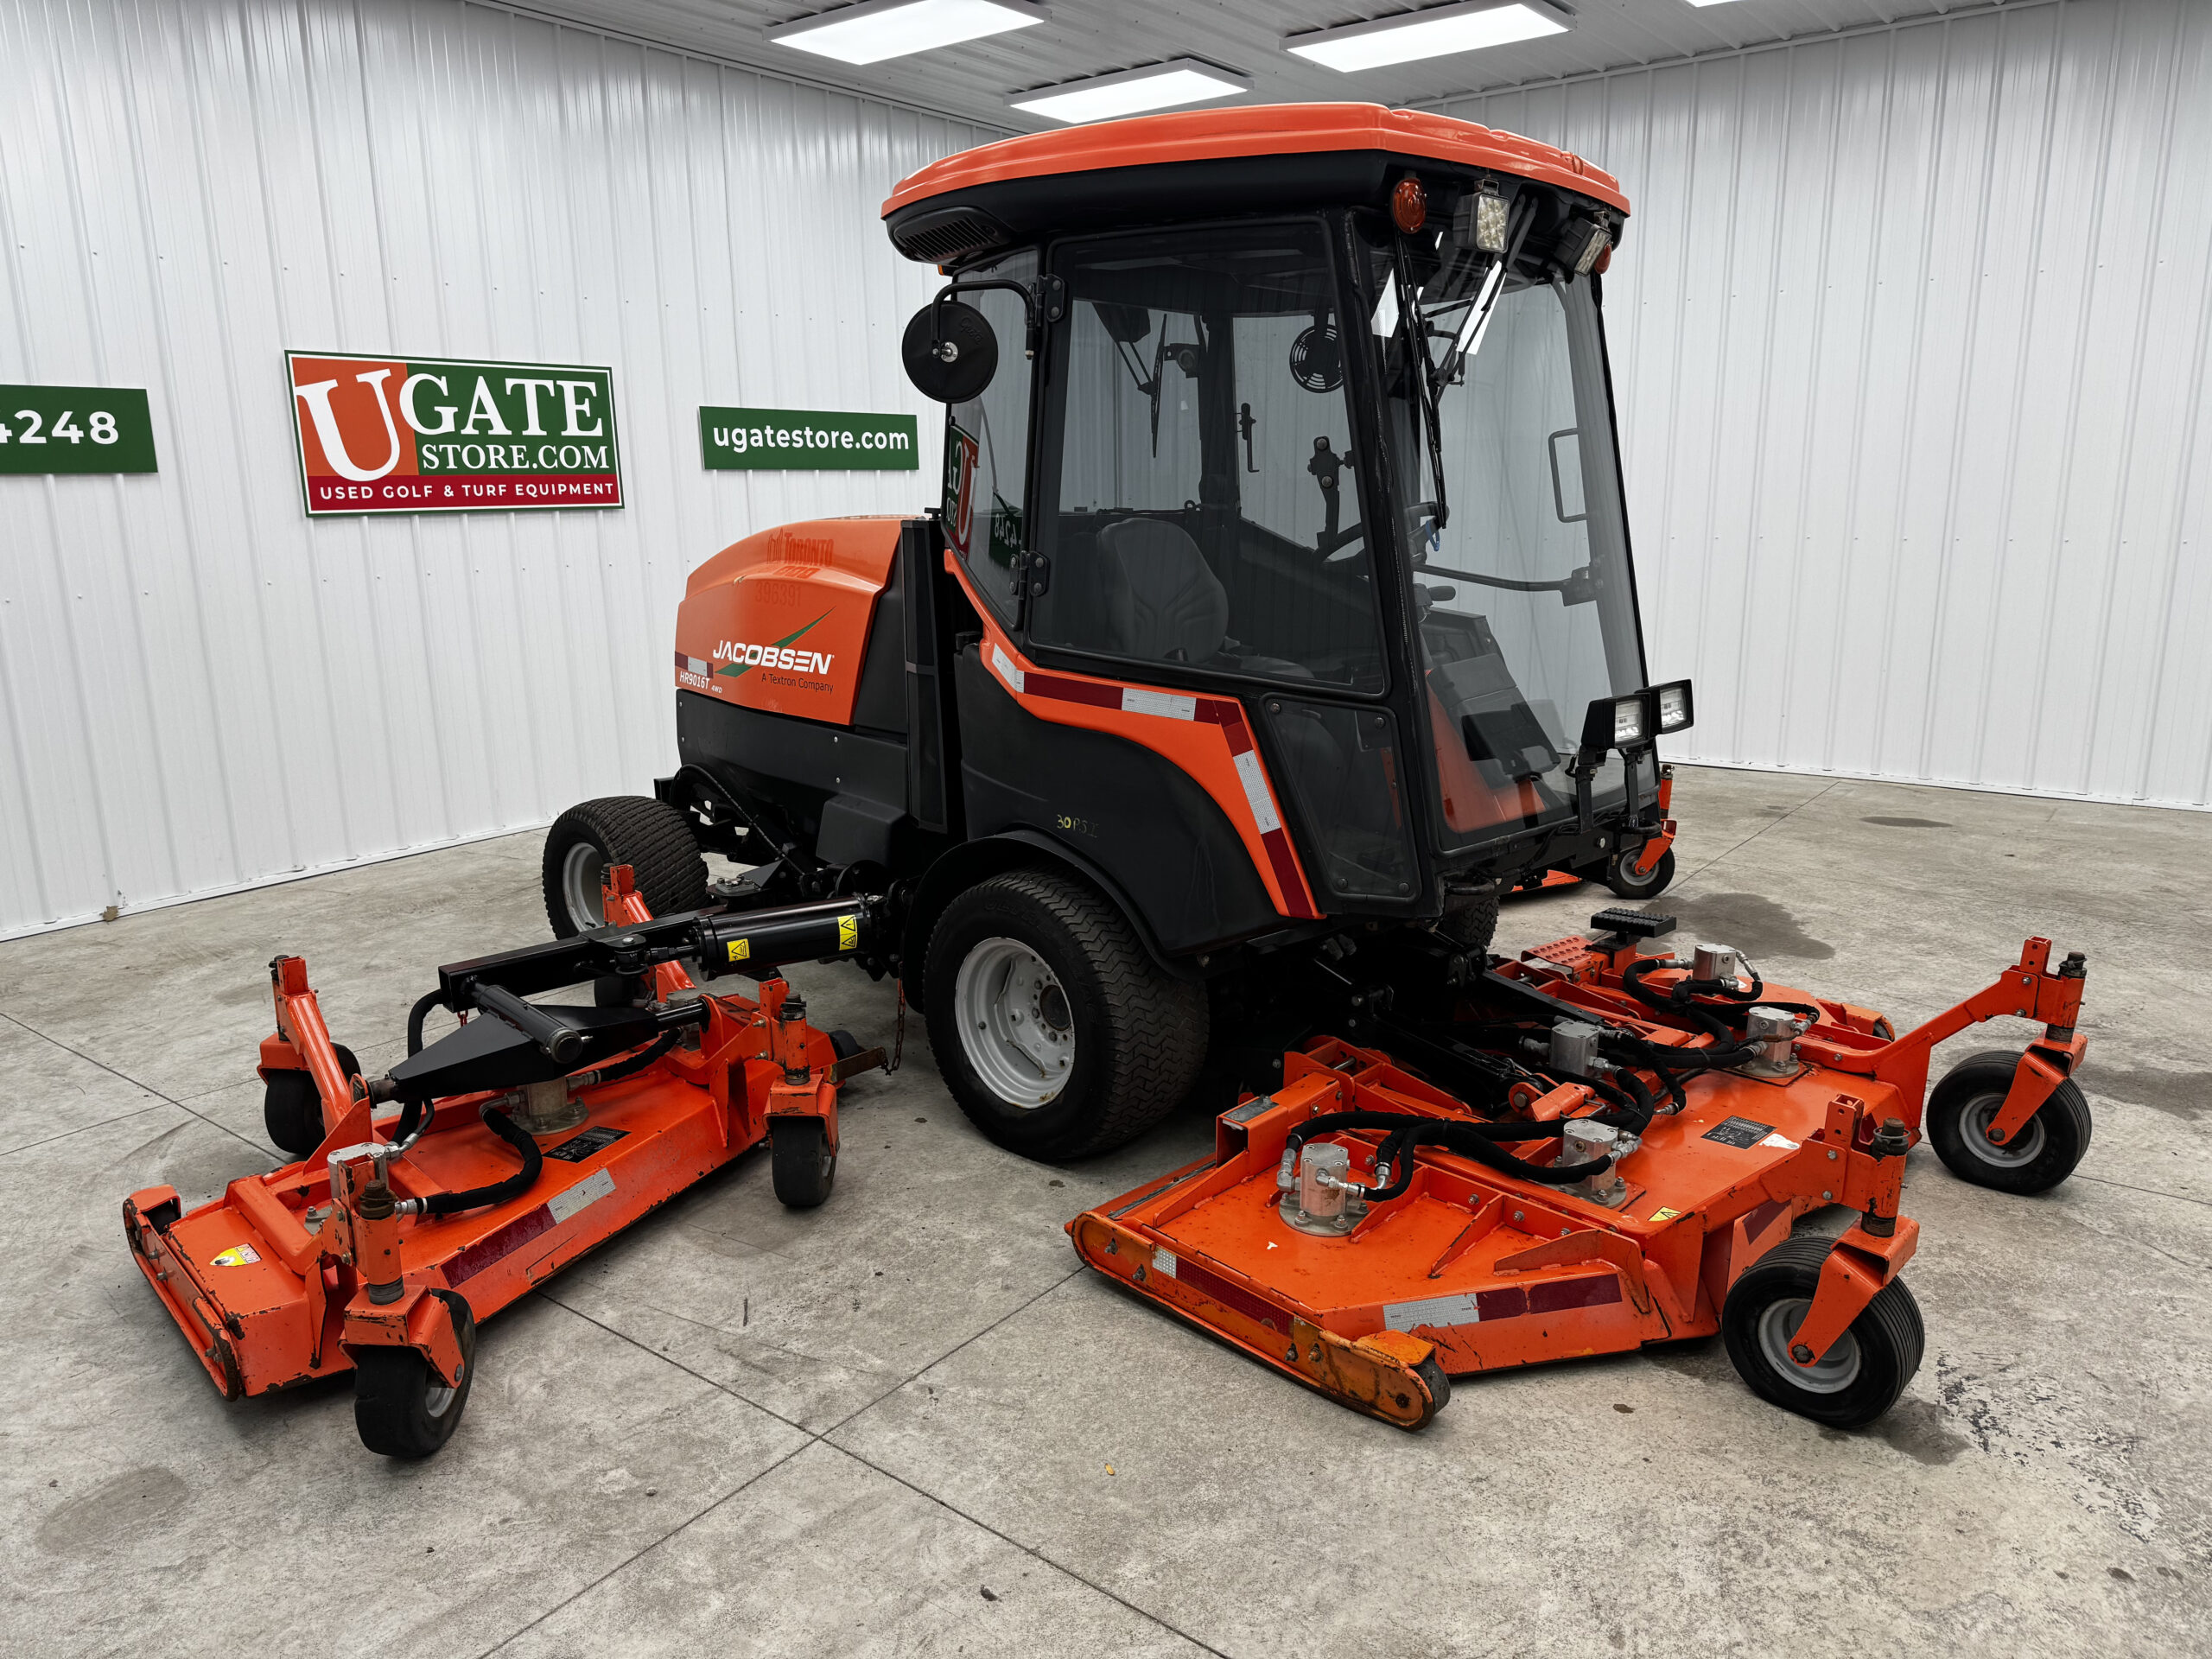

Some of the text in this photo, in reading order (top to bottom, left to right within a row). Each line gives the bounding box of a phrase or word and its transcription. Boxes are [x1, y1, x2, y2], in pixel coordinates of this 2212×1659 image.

[713, 425, 910, 454] ugatestore.com
[422, 443, 610, 471] STORE.COM
[320, 482, 613, 500] USED GOLF & TURF EQUIPMENT
[712, 639, 833, 676] JACOBSEN
[679, 671, 722, 694] HR9016T 4WD
[761, 672, 834, 694] A Textron Company
[1057, 813, 1072, 830] 30
